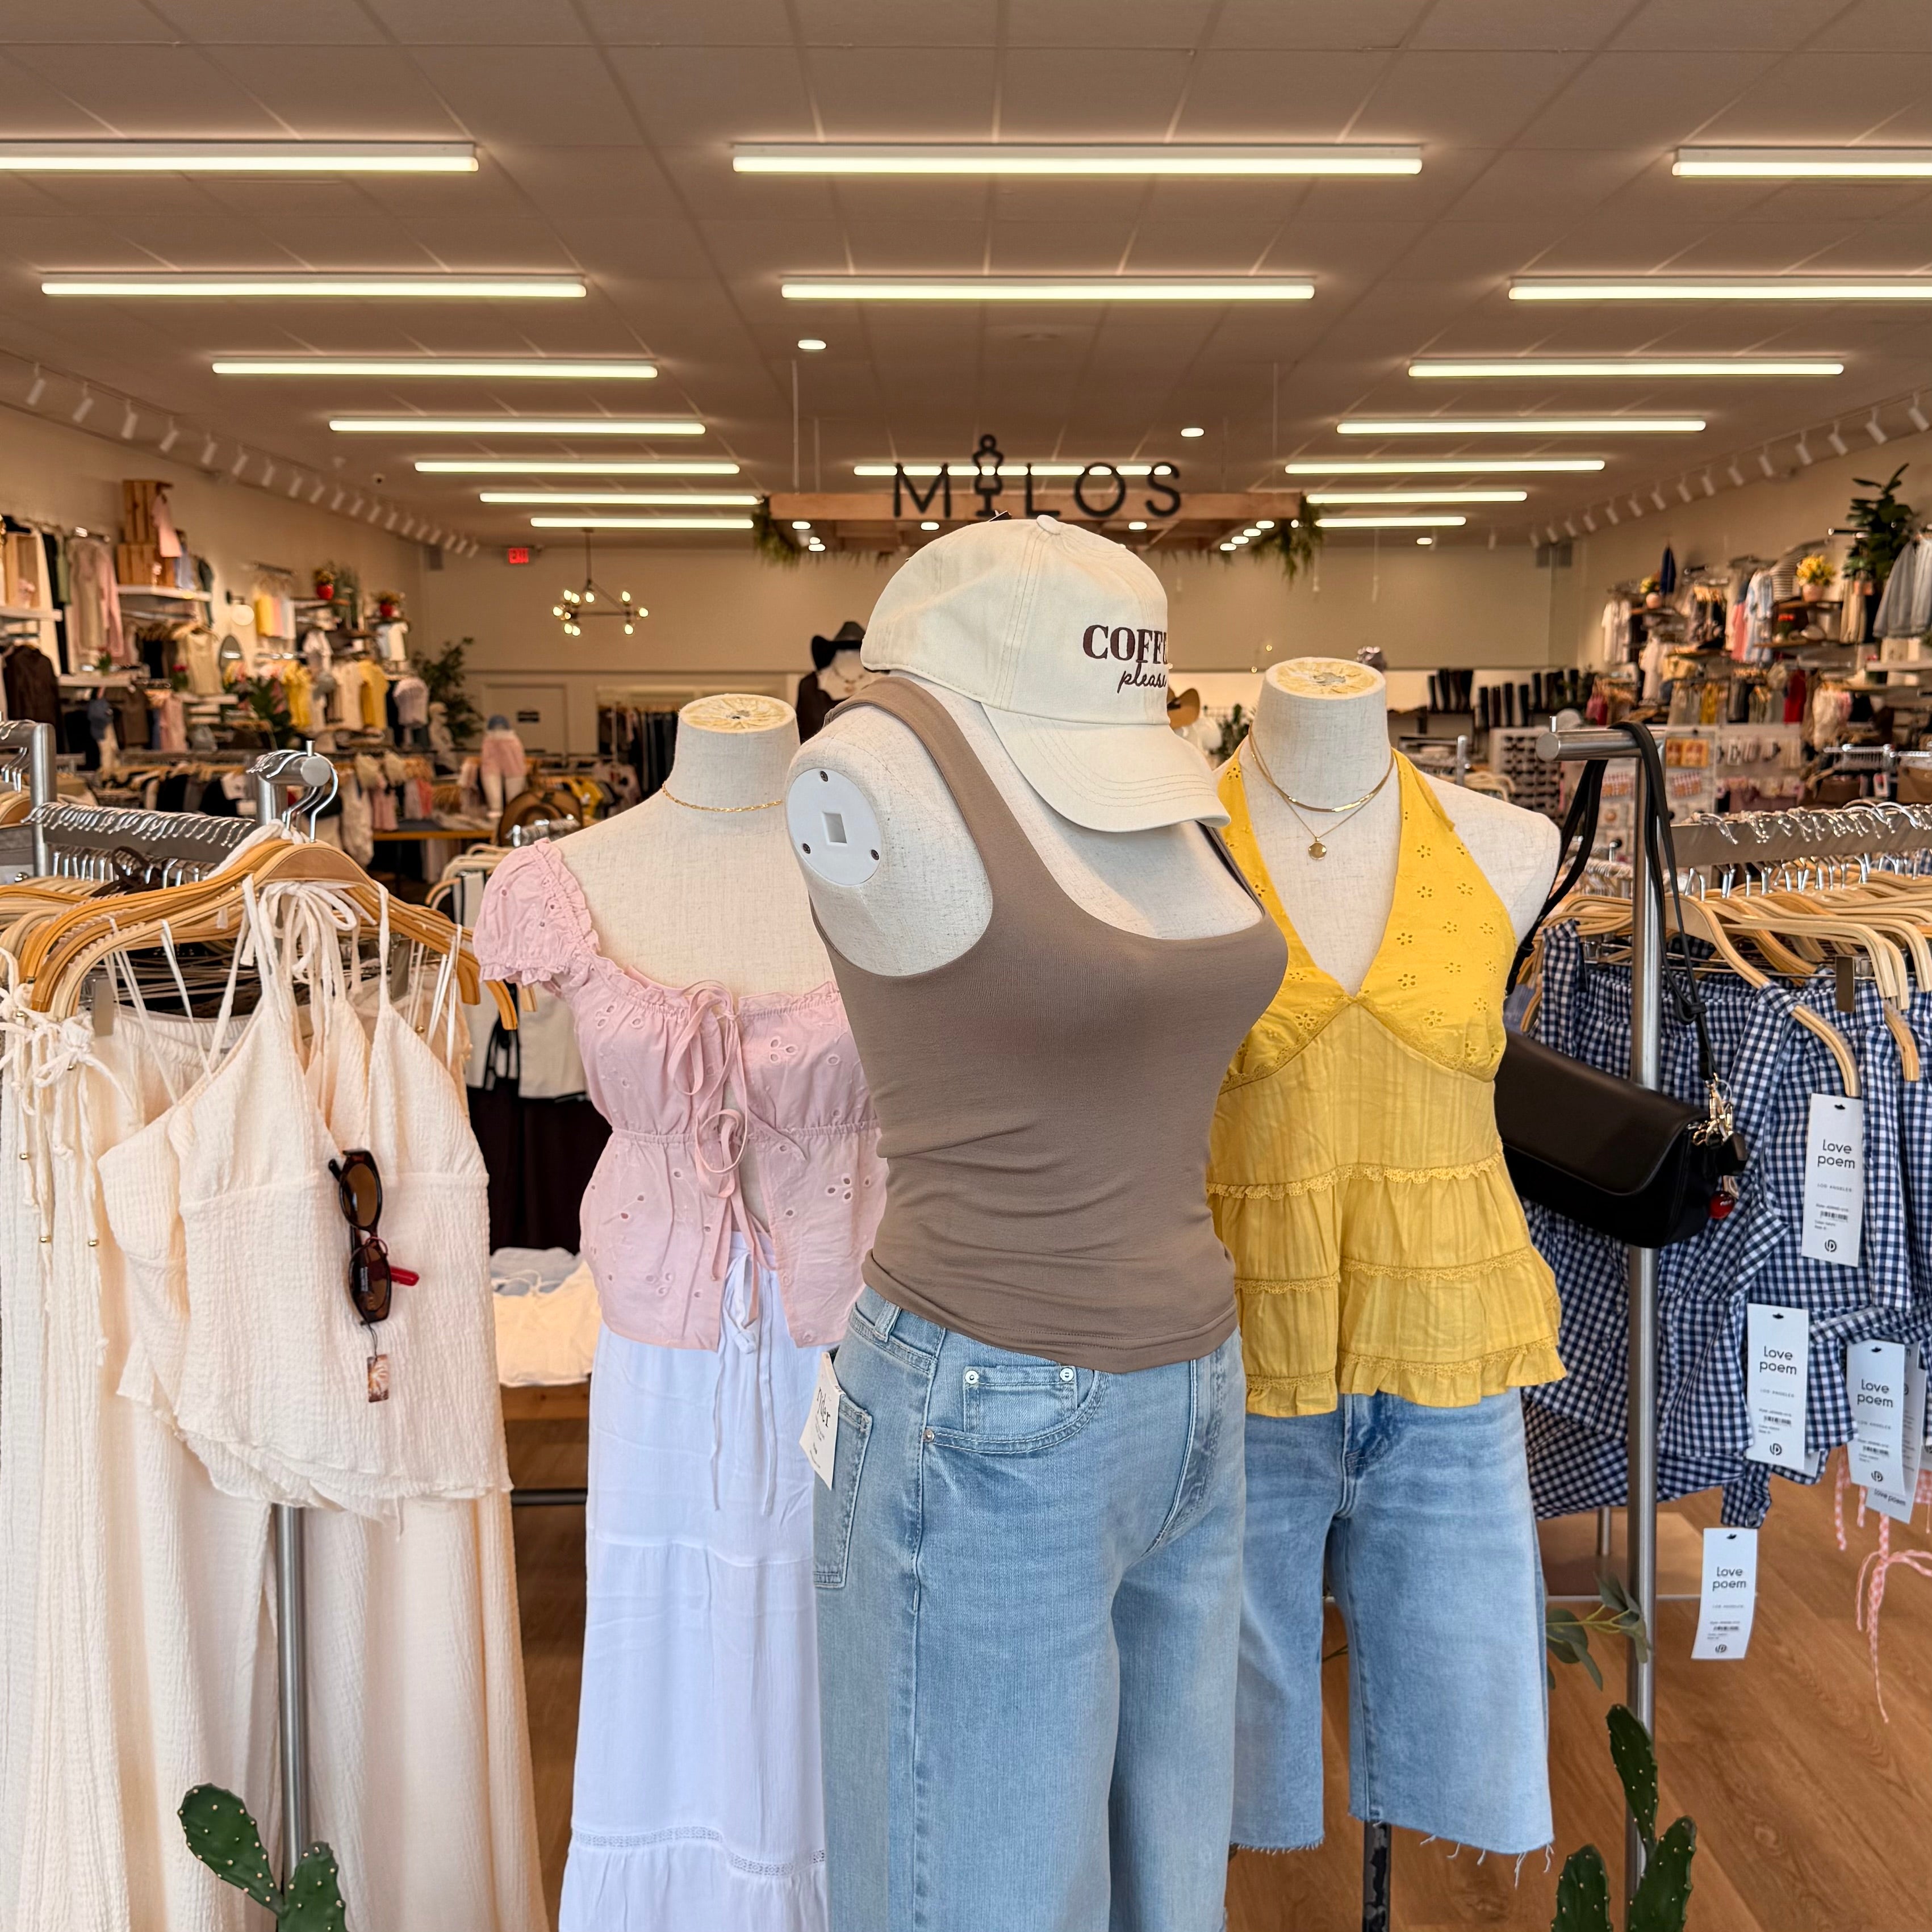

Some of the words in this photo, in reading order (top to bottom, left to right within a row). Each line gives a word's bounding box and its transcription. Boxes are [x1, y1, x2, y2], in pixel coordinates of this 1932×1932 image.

[1822, 1139, 1852, 1154] Love
[1817, 1155, 1855, 1169] poem
[1764, 1345, 1793, 1361] Love
[1759, 1361, 1797, 1375] poem
[1861, 1378, 1889, 1394] Love
[1857, 1394, 1893, 1408] poem
[1716, 1566, 1743, 1577] Love
[1712, 1580, 1746, 1592] poem
